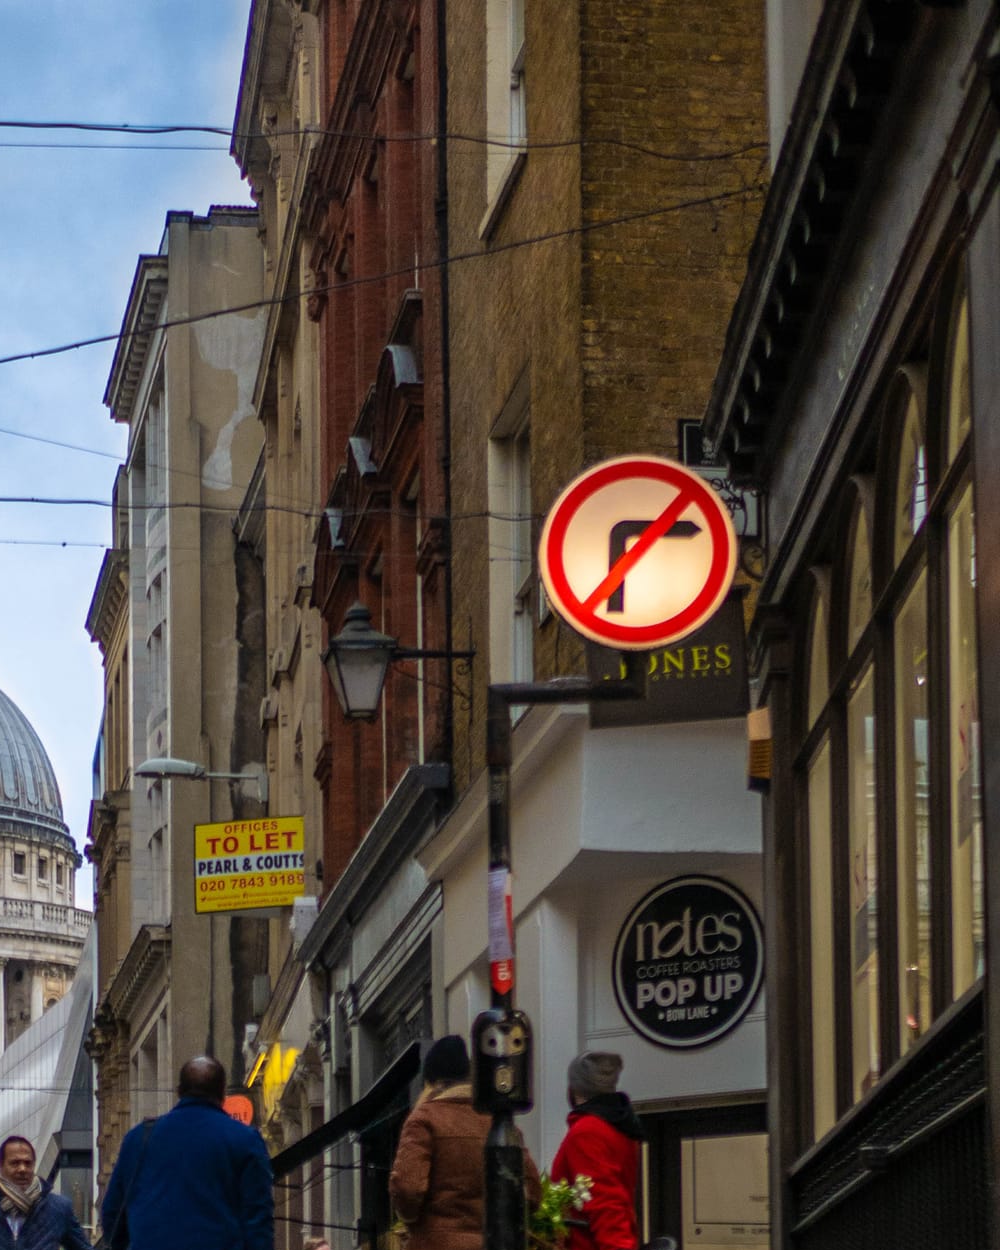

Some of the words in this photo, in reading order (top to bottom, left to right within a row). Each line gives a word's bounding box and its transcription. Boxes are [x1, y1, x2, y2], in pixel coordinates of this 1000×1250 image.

[224, 821, 278, 834] OFFICES
[206, 836, 239, 855] TO
[249, 831, 298, 851] LET
[198, 859, 239, 876] PEARL
[242, 857, 252, 871] &
[256, 853, 304, 871] COUTTS
[200, 880, 226, 892] 020
[230, 876, 265, 890] 7843
[635, 906, 743, 962] notes
[636, 962, 681, 980] COFFEE
[682, 955, 742, 975] ROASTERS
[636, 977, 697, 1009] POP
[702, 971, 744, 1003] UP
[666, 1007, 685, 1022] BOW
[686, 1005, 710, 1020] LANE
